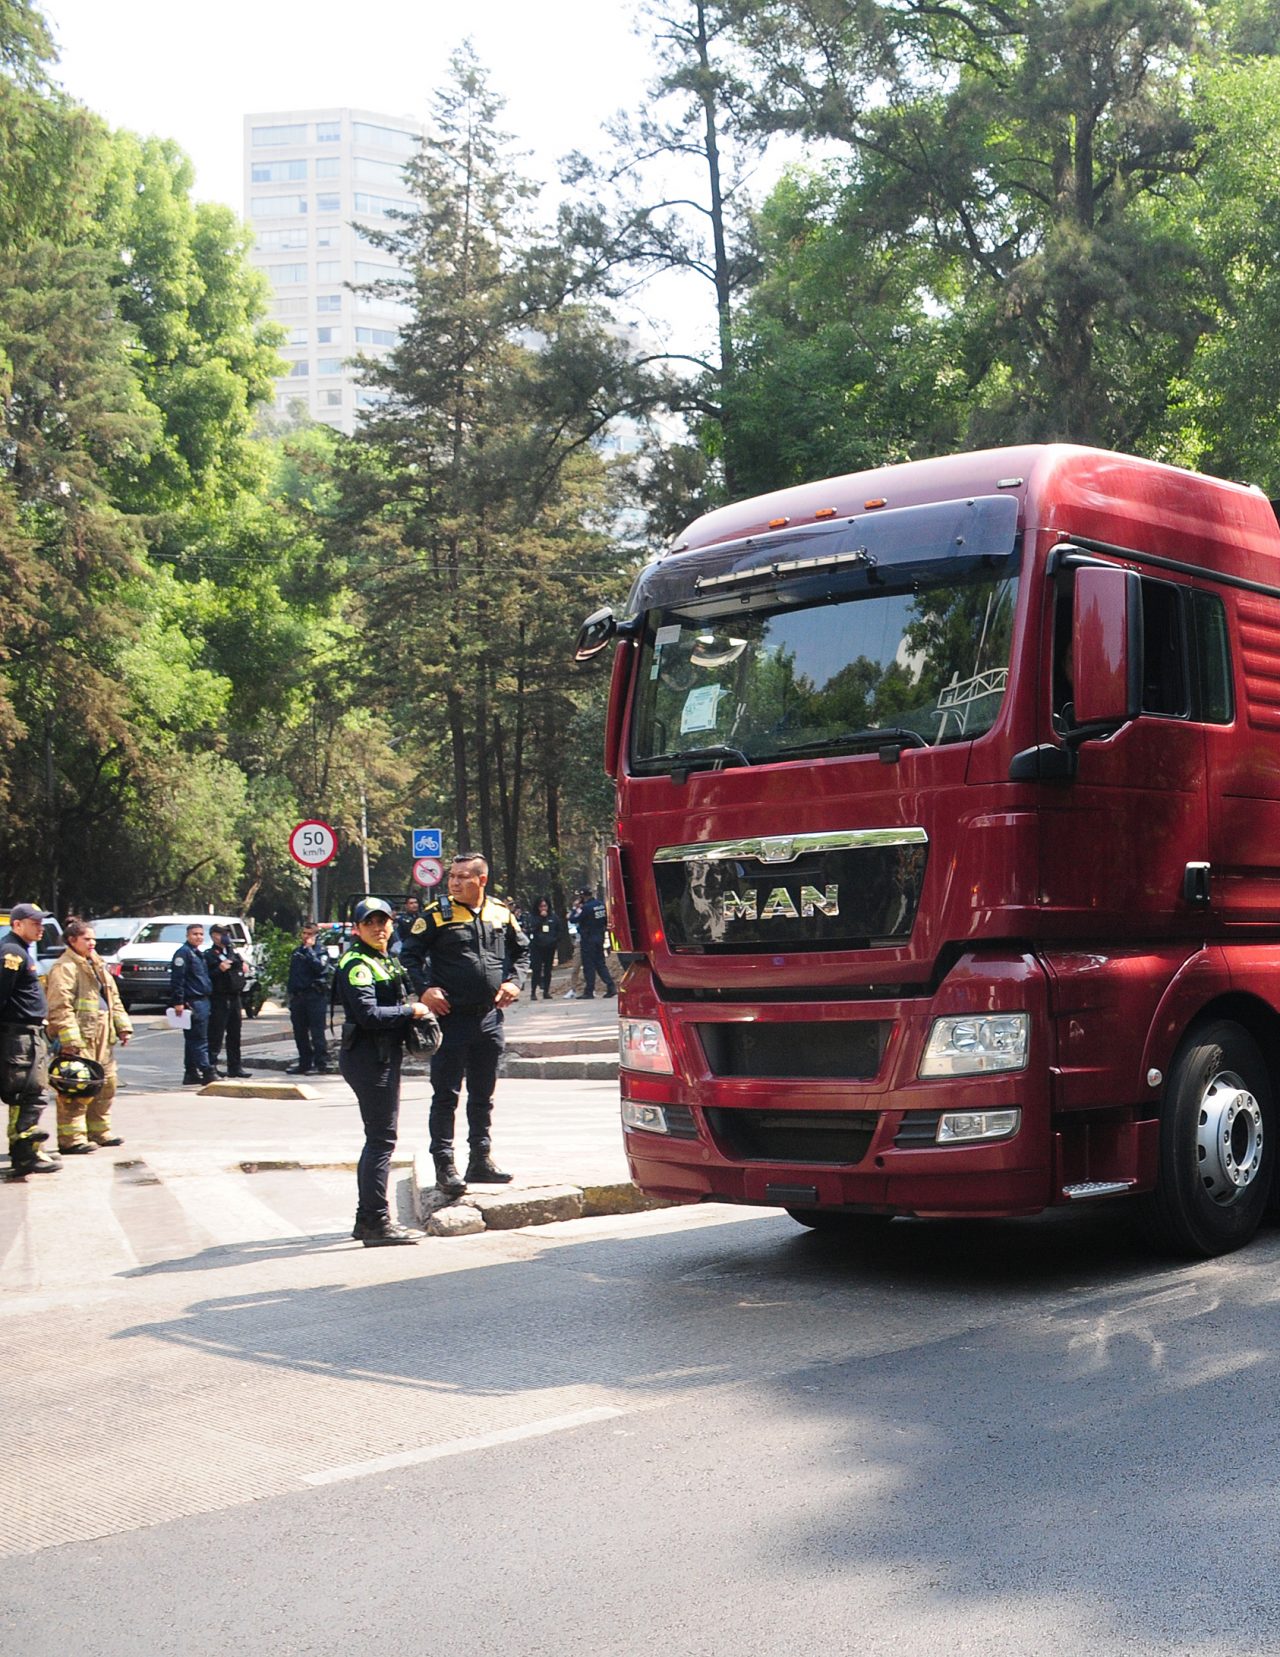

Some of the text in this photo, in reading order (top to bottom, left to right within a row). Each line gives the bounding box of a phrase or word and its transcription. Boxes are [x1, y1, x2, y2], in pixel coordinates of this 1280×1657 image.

[303, 831, 324, 846] 50
[303, 848, 326, 856] km/h
[722, 884, 840, 921] MAN
